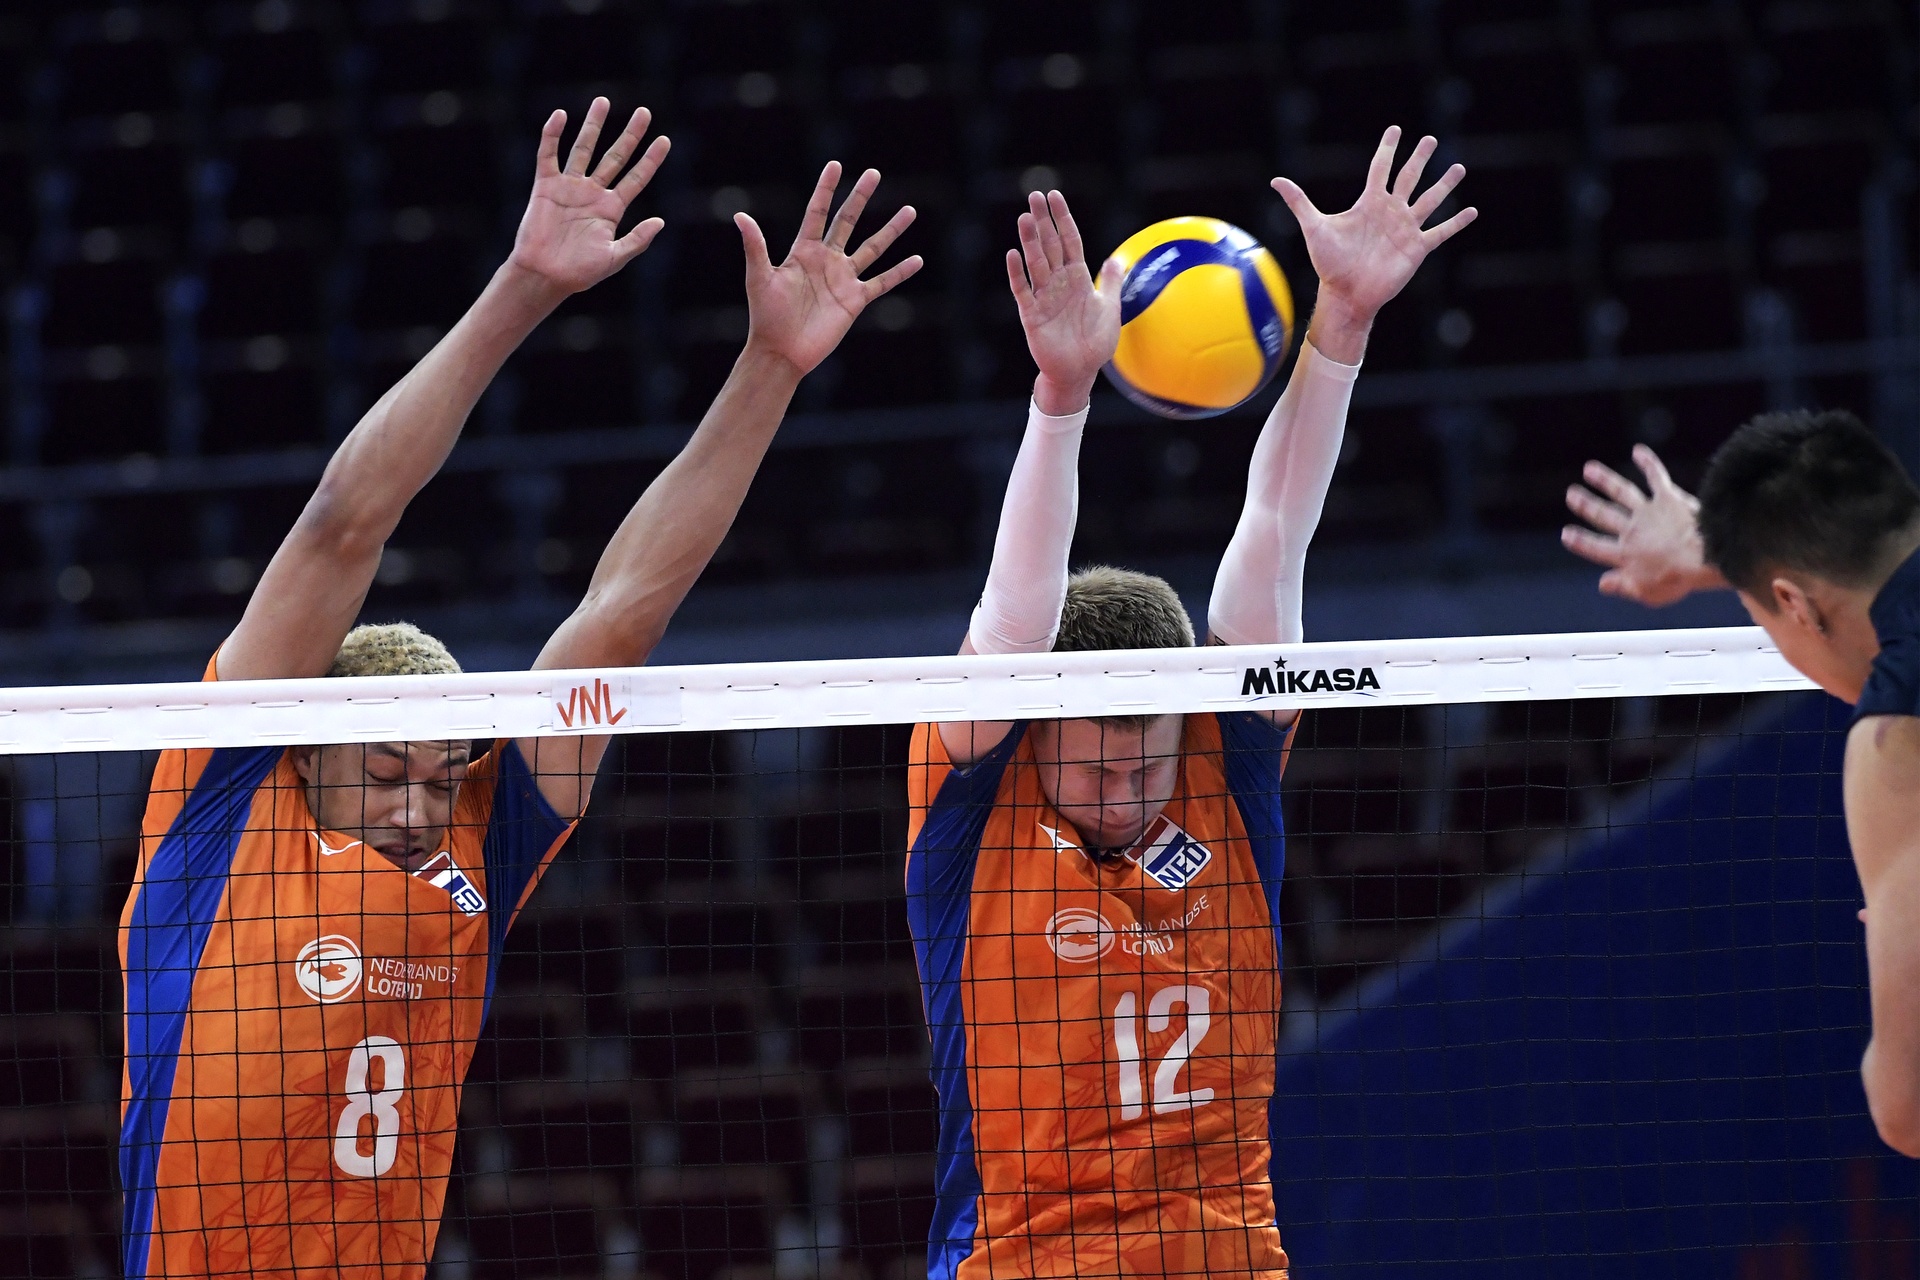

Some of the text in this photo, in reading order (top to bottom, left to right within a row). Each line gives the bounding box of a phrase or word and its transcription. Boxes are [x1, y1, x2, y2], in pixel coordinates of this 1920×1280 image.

[1241, 657, 1381, 696] MIKASA
[556, 678, 628, 728] VNL
[1157, 843, 1207, 889] NED
[1113, 985, 1215, 1121] 12
[334, 1035, 405, 1178] 8
